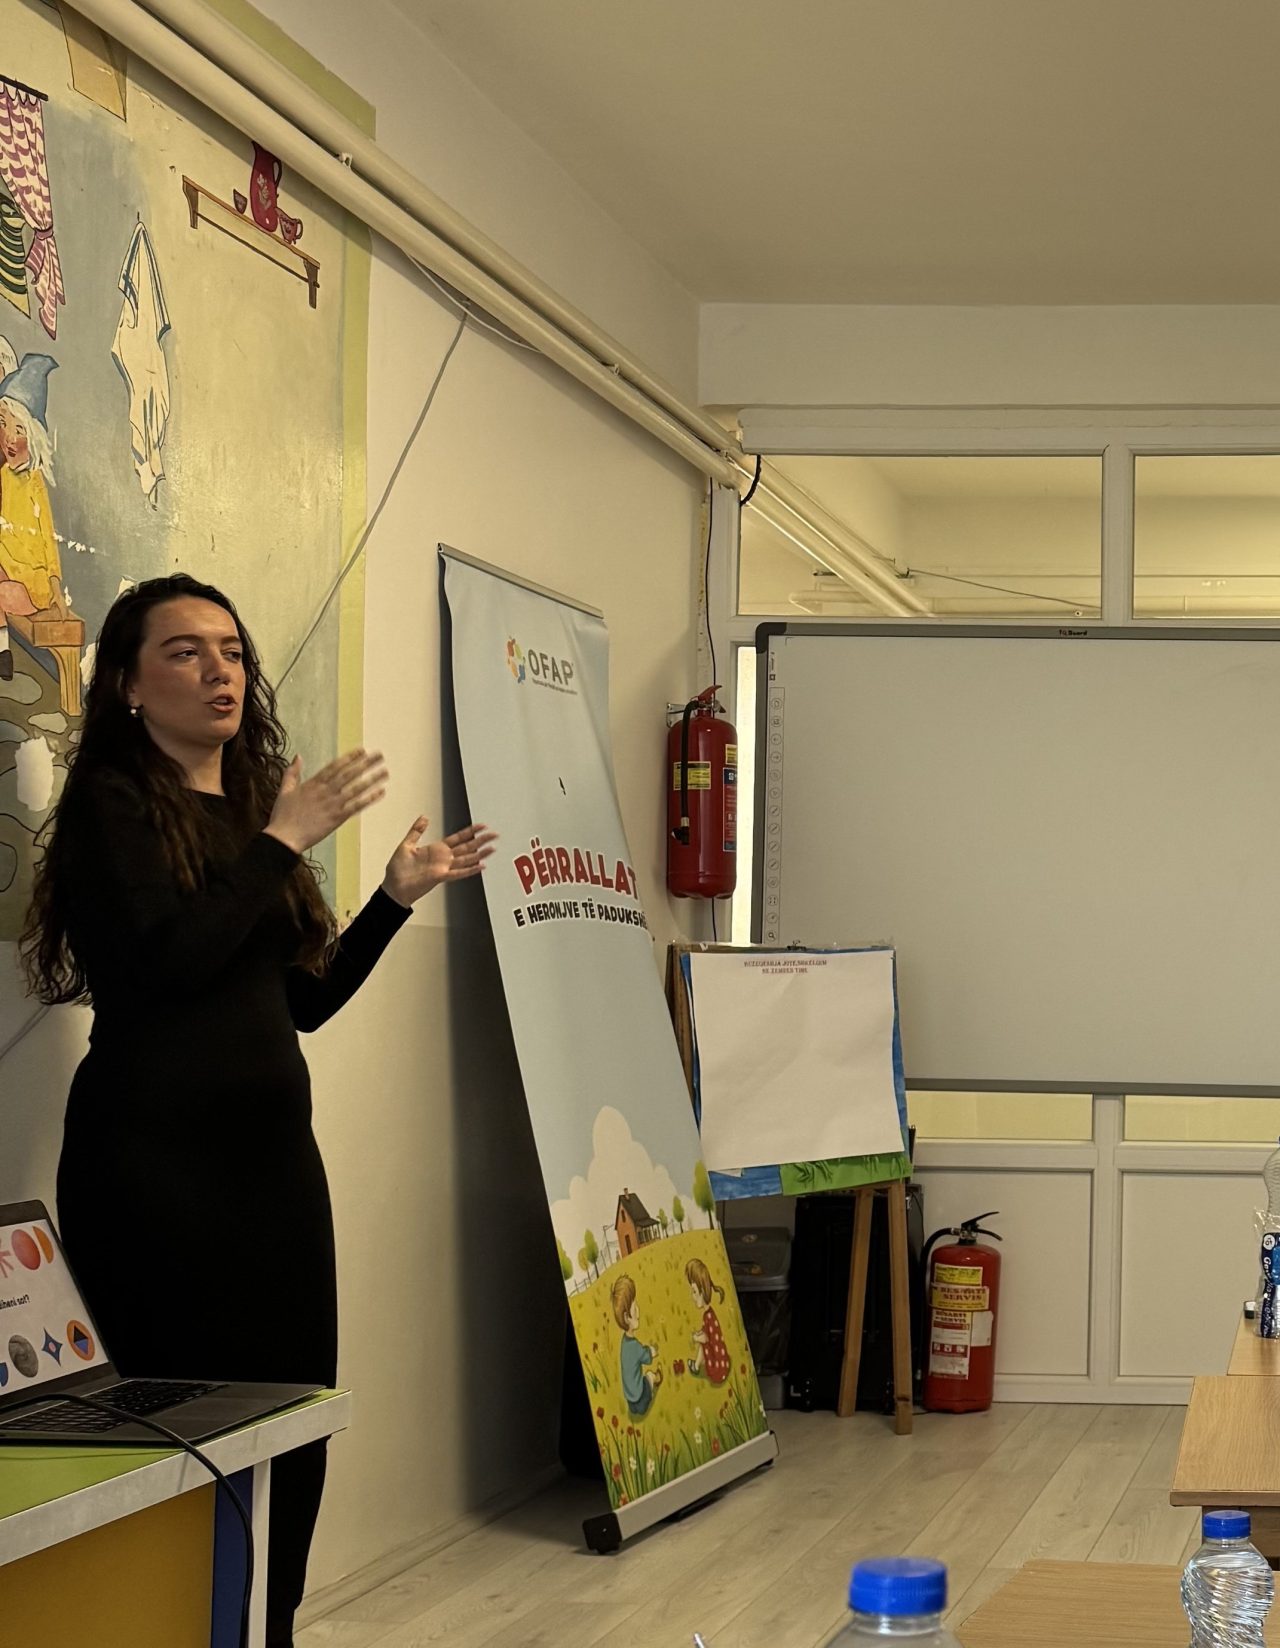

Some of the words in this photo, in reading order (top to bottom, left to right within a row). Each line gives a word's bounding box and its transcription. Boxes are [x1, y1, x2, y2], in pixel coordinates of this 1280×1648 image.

[528, 649, 574, 686] OFAP
[513, 836, 638, 900] PËRRALLAT
[513, 908, 526, 928] E
[526, 901, 581, 924] HERONJVE
[581, 898, 596, 919] TË
